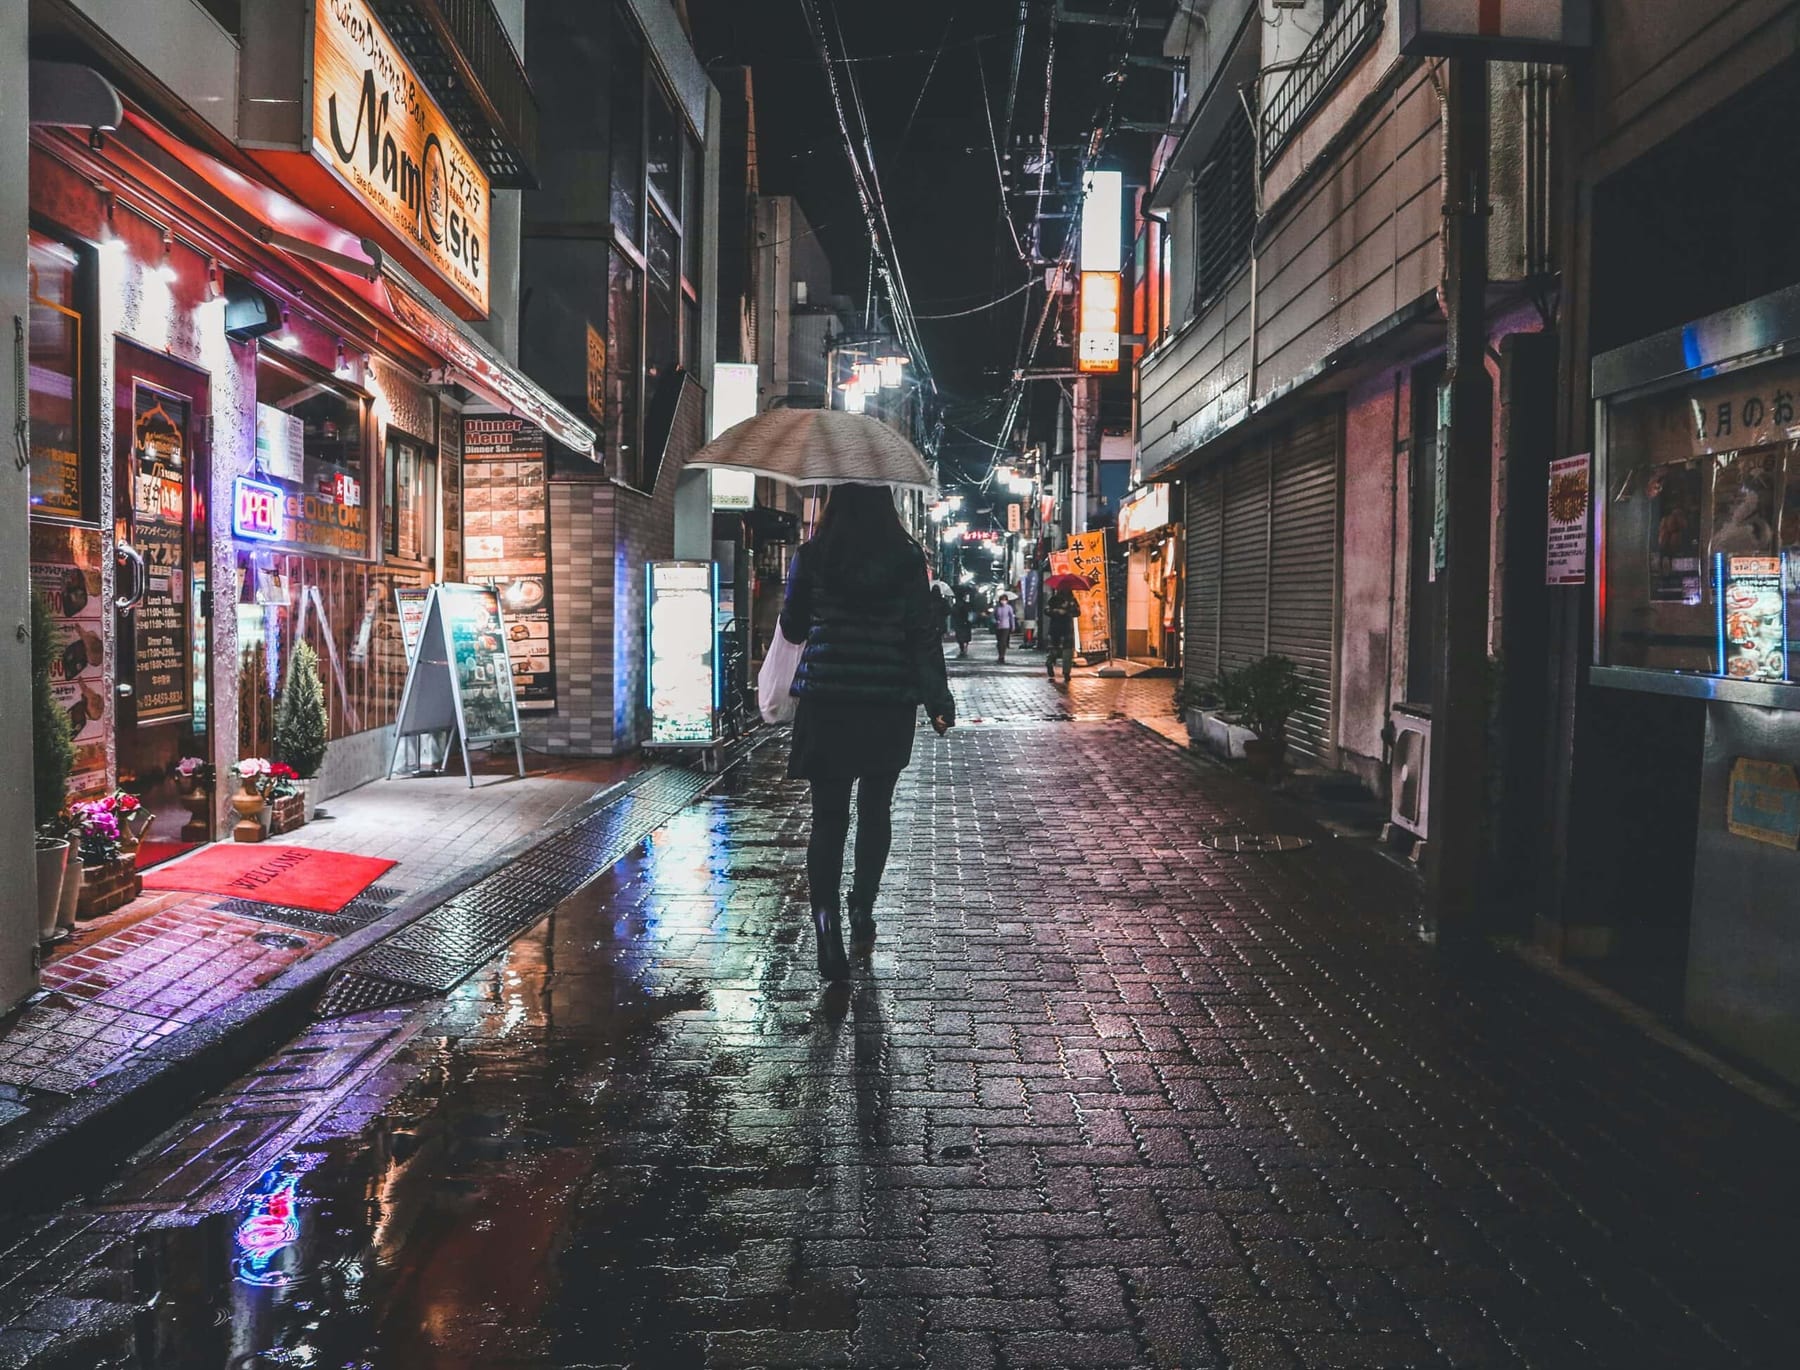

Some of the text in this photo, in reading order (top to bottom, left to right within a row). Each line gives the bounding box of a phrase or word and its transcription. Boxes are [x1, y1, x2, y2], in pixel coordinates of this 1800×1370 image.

[408, 81, 425, 132] Bar
[449, 156, 480, 214] ナマステ
[464, 420, 522, 432] Dinner
[464, 432, 512, 445] Menu
[240, 487, 277, 532] OPEN
[305, 496, 335, 524] Out
[135, 539, 182, 567] ナマステ
[226, 849, 313, 891] WELCOME
